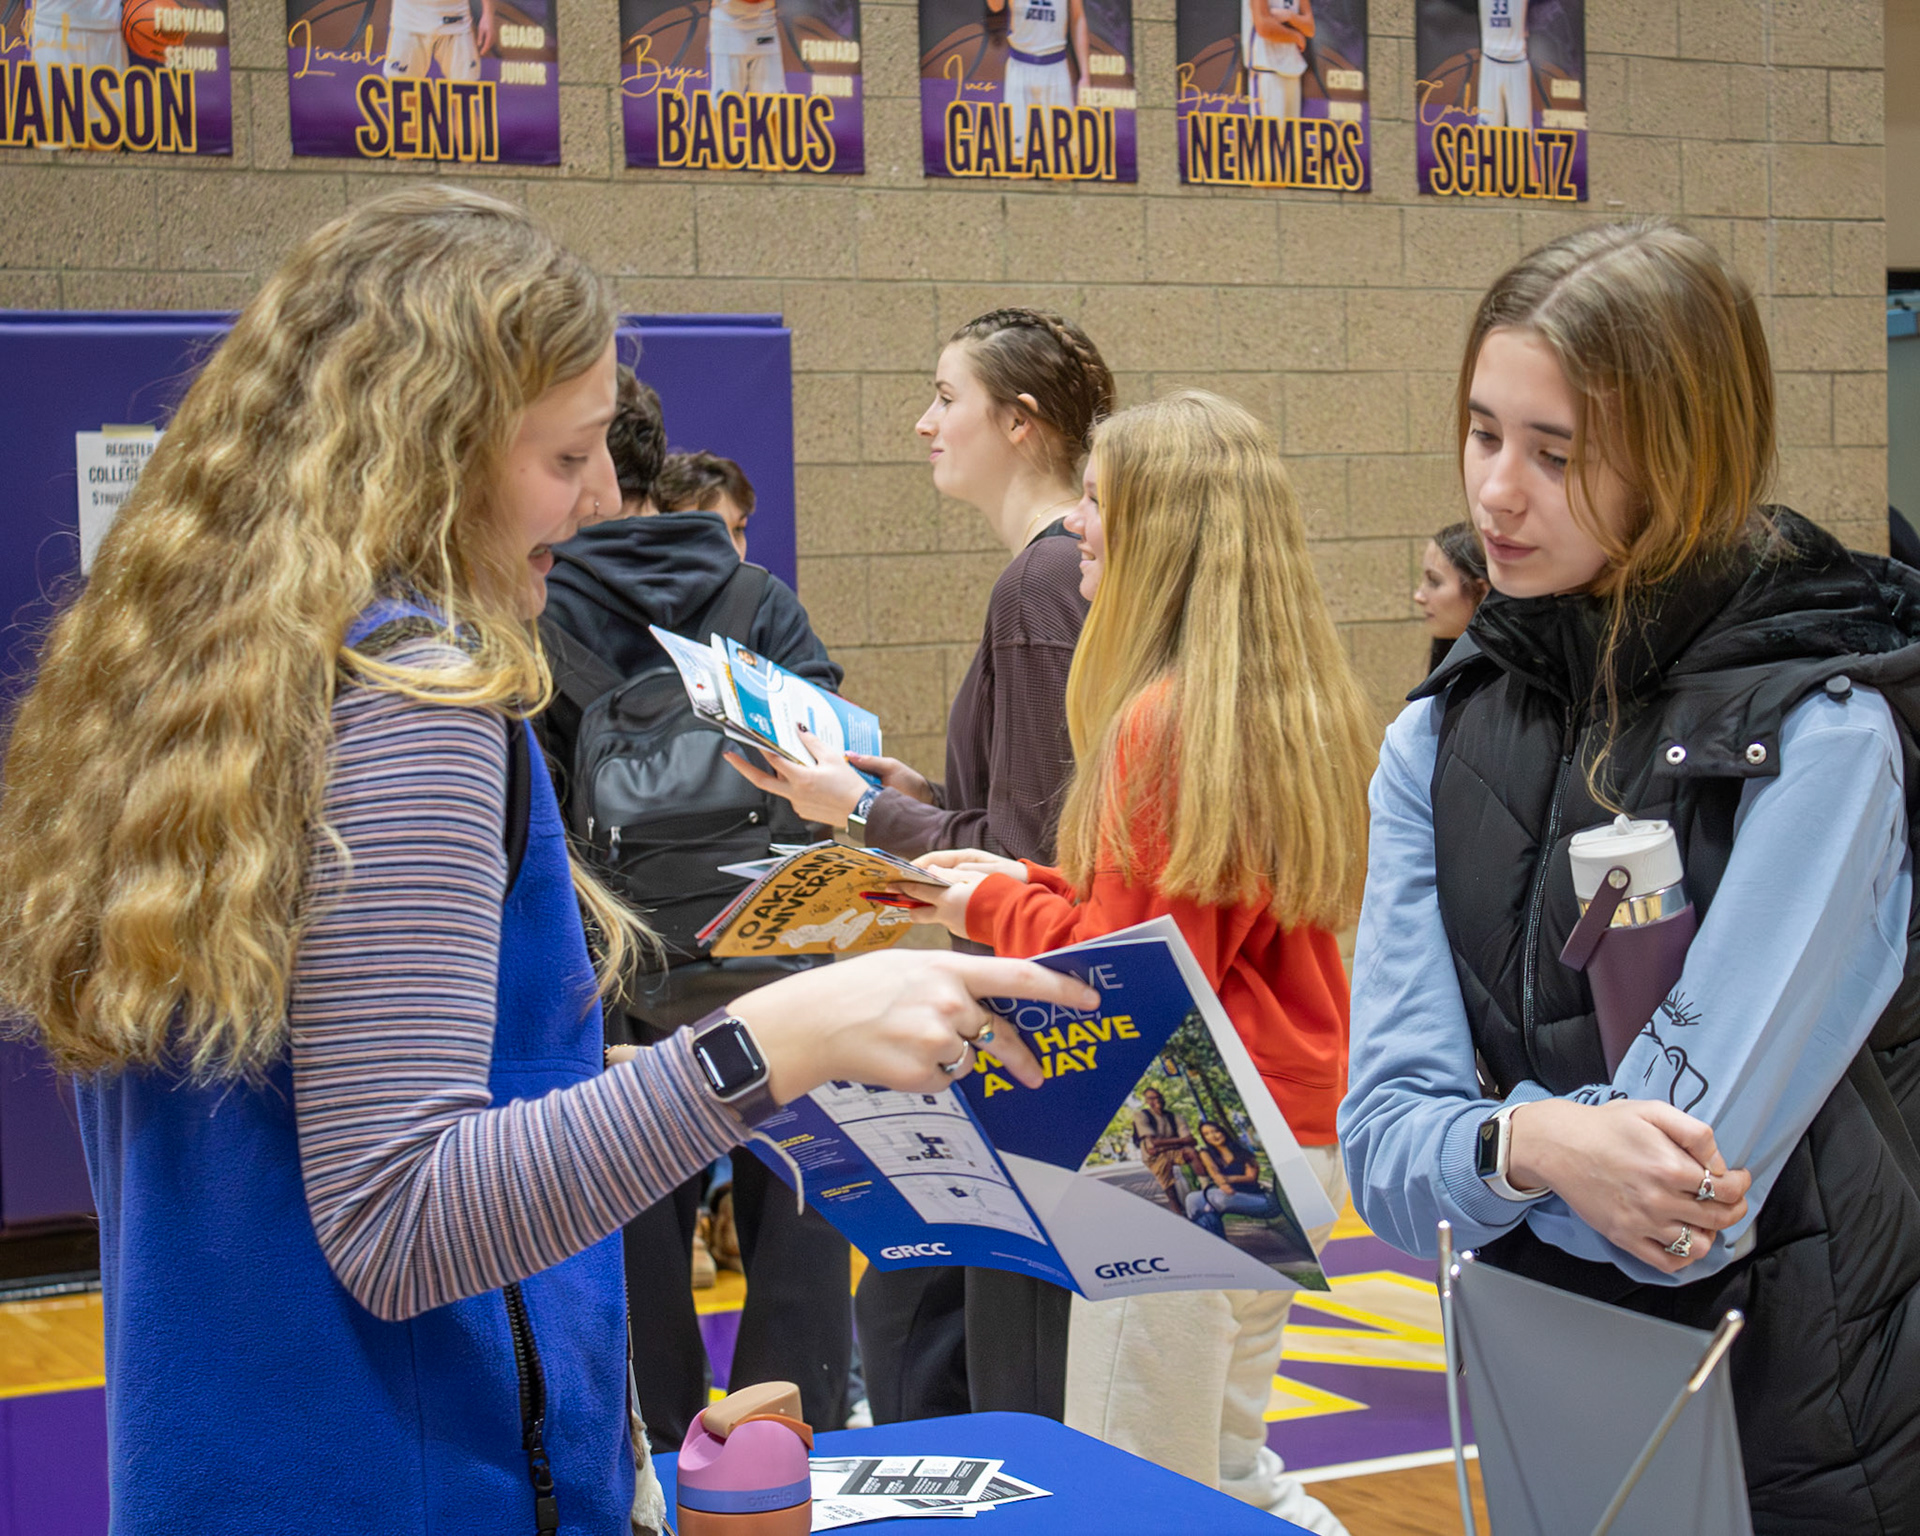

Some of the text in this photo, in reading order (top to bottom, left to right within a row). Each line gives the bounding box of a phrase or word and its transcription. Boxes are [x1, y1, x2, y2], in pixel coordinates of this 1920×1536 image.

[153, 7, 225, 34] FORWARD
[500, 24, 546, 49] GUARD
[164, 46, 218, 71] SENIOR
[287, 19, 396, 79] Lincoln
[500, 62, 547, 86] JUNIOR
[621, 34, 709, 100] Bryce
[0, 60, 197, 152] ANSON
[355, 74, 499, 162] SENTI
[656, 88, 836, 172] BACKUS
[945, 100, 1117, 180] GALARDI
[1187, 111, 1364, 191] NEMMERS
[1430, 122, 1578, 200] SCHULTZ
[738, 851, 846, 940] OAKLAND
[1013, 1002, 1101, 1032] OAL,
[1033, 1014, 1142, 1054] HAVE
[984, 1072, 1015, 1099] A
[880, 1242, 953, 1260] GRCC
[1094, 1256, 1171, 1280] GRCC
